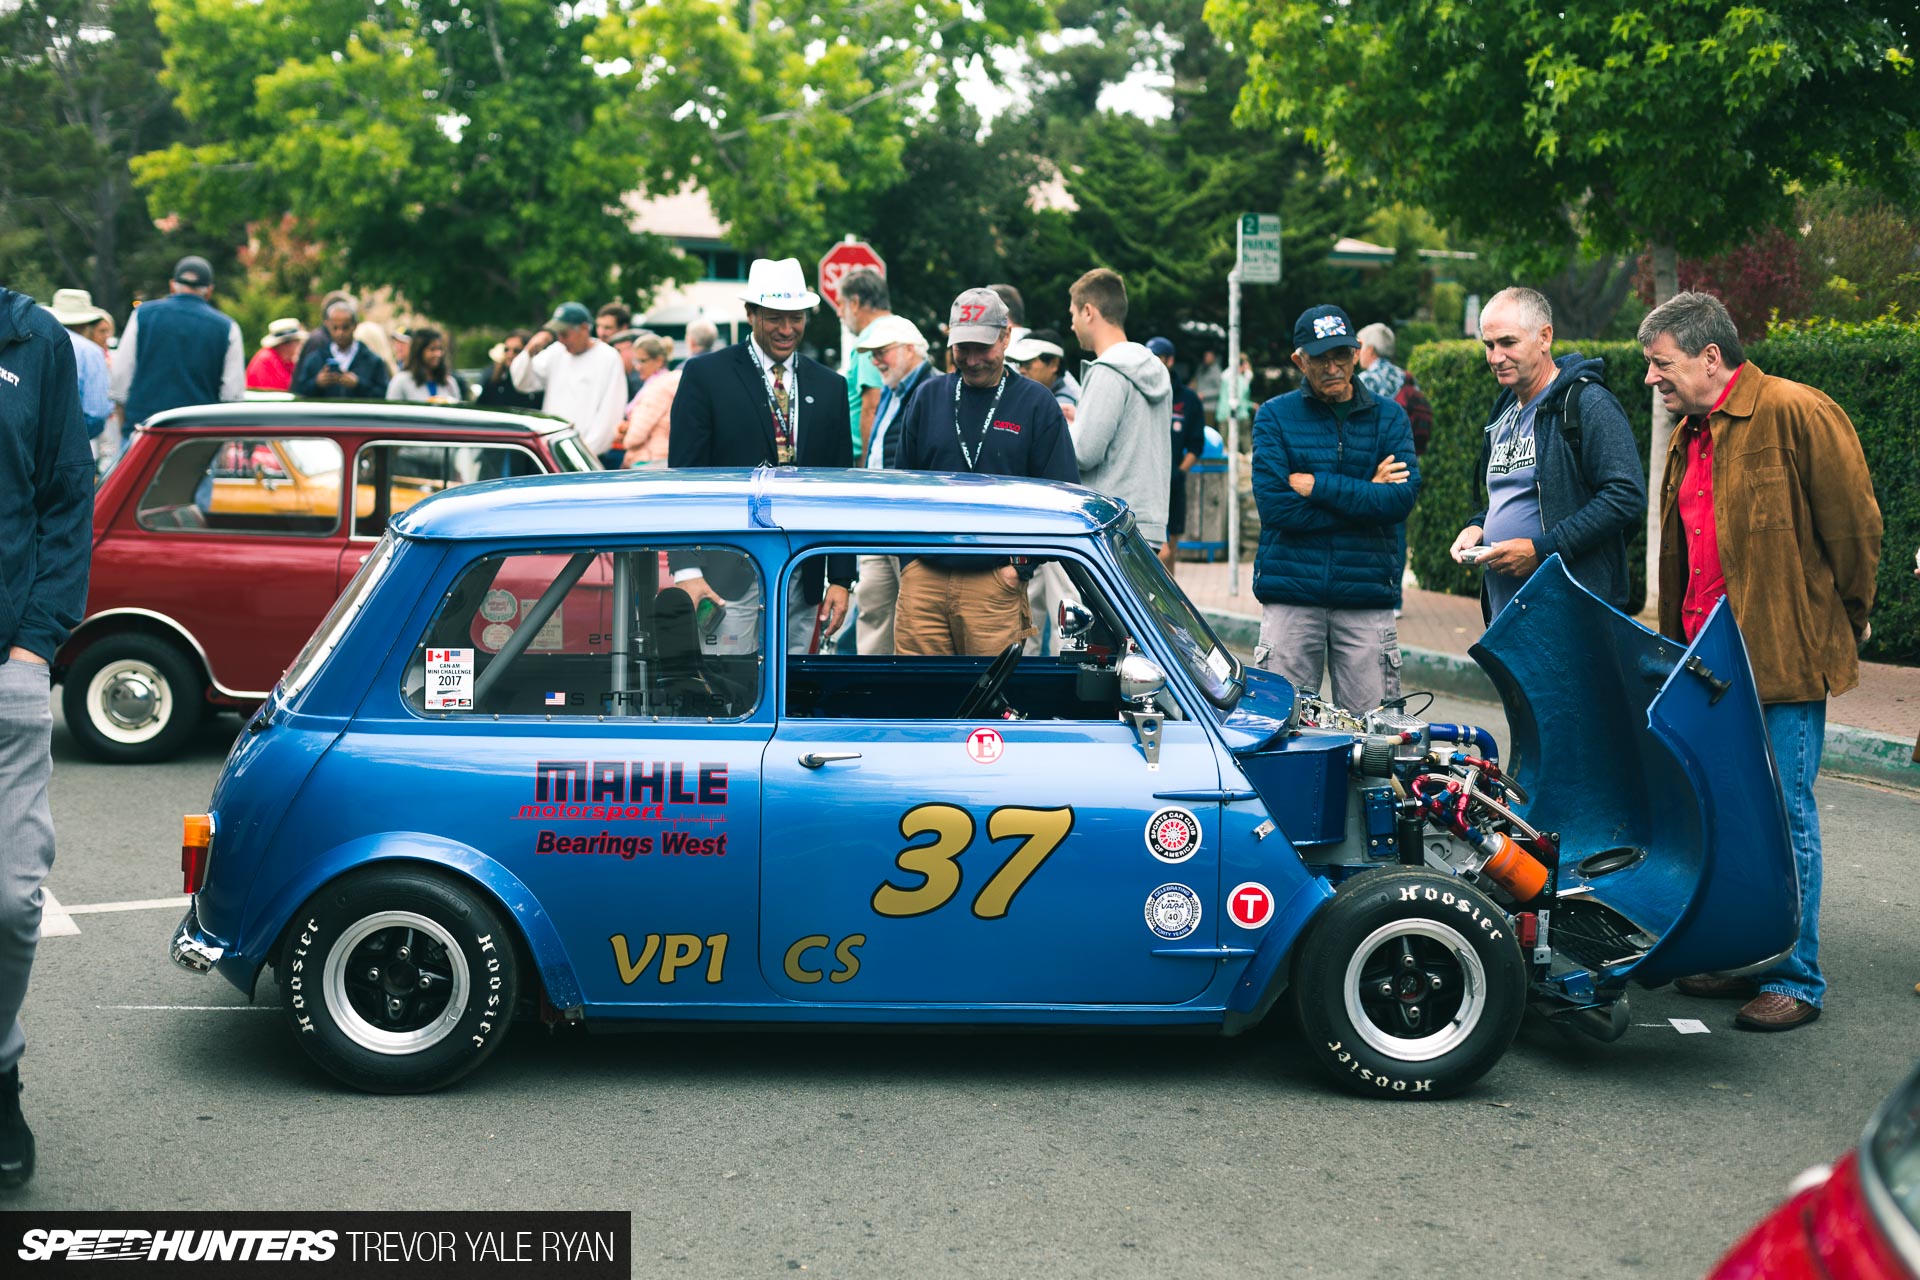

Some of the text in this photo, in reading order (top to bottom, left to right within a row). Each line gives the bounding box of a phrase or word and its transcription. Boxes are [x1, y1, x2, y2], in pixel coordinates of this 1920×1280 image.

[1244, 217, 1256, 233] 2
[1243, 239, 1279, 252] PARKING
[959, 305, 986, 323] 37
[983, 408, 996, 431] ACURA
[439, 676, 462, 686] 2017
[975, 733, 996, 758] E
[535, 760, 728, 805] MAHLE
[518, 803, 665, 822] motorsport
[1151, 812, 1197, 839] SPORTS CAR CLUB
[535, 830, 728, 860] Bearings West
[1154, 842, 1195, 858] OF AMERICA
[870, 801, 1076, 921] 37
[1154, 885, 1191, 898] CELEBRATING
[1161, 902, 1185, 911] VARA
[1167, 913, 1179, 921] 40
[1240, 894, 1262, 919] T
[1398, 884, 1503, 940] Hoosier
[1155, 926, 1191, 937] FORTY YEARS
[1156, 917, 1190, 930] ASSOCIATION
[608, 933, 867, 986] VP1 CS
[290, 918, 319, 1034] Hoosier
[476, 933, 502, 1048] Hoosier
[1327, 1041, 1437, 1093] Hoosier
